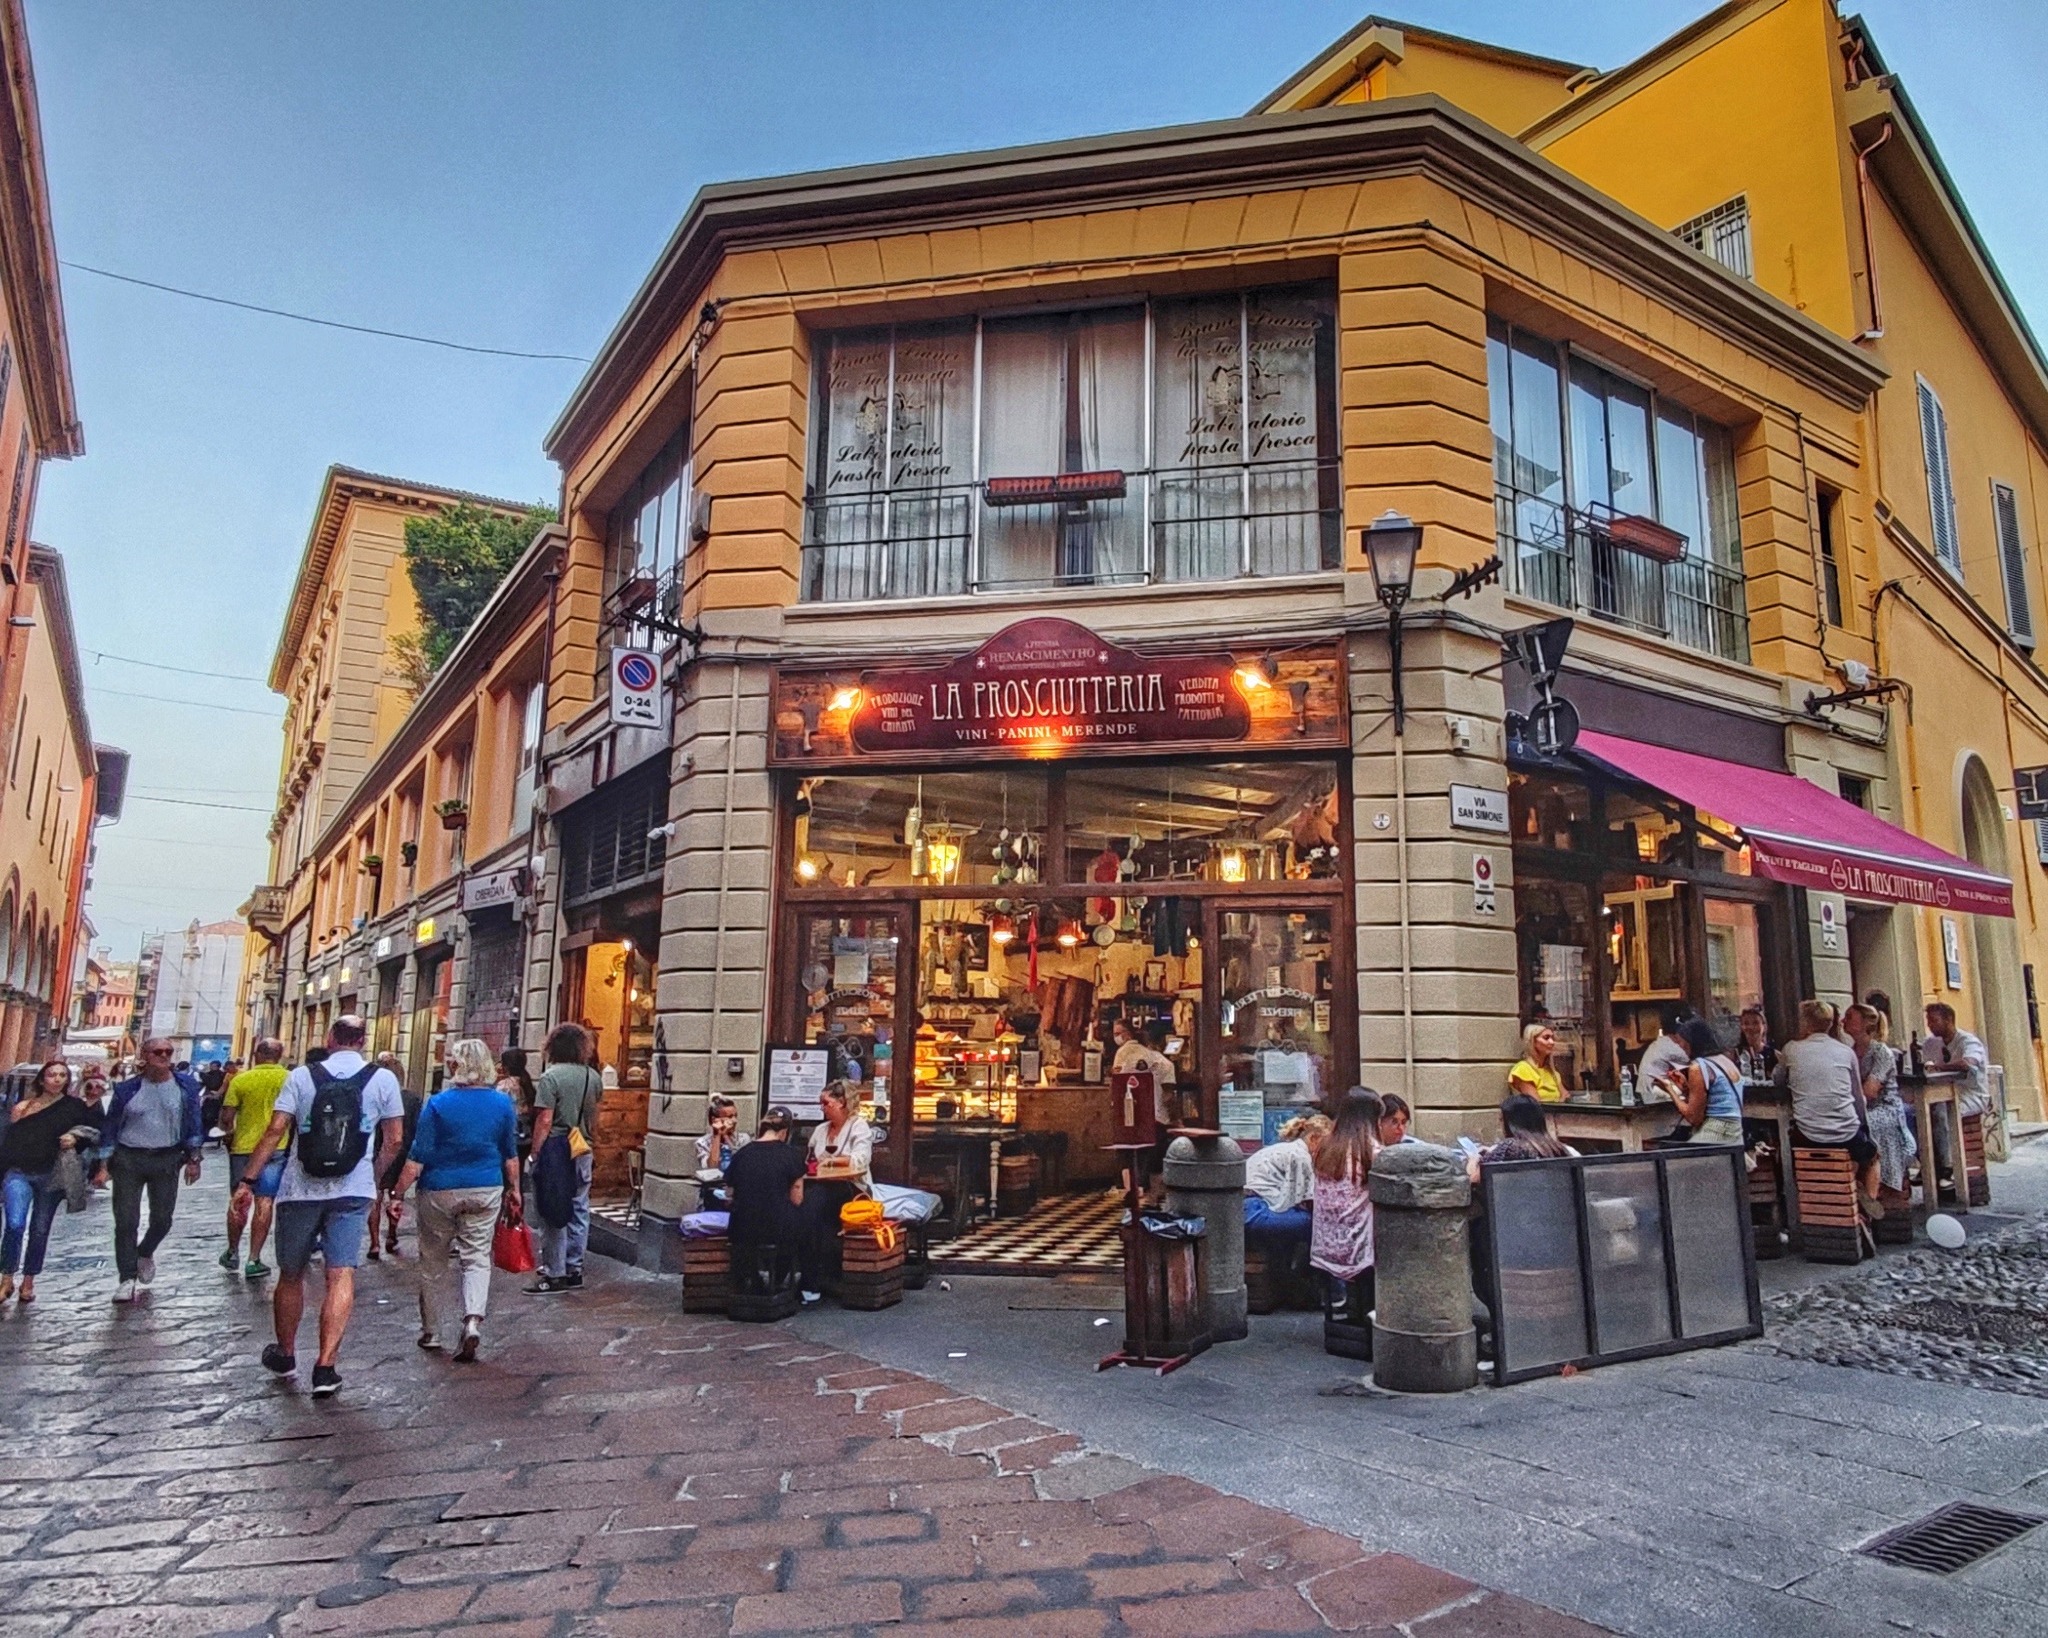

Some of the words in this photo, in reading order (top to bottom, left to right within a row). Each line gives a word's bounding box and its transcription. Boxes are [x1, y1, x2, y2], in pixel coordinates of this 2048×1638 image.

[1186, 412, 1306, 435] Laboatorio
[836, 442, 943, 462] Laboatorio
[1179, 438, 1240, 462] pasta
[1252, 432, 1316, 457] fresca
[828, 467, 882, 489] pasta
[893, 461, 951, 485] fresca
[990, 648, 1095, 662] RENASCIMENTHO
[1179, 677, 1219, 691] VENDITA
[624, 696, 651, 707] 0-24
[870, 692, 924, 709] PRODUZIONE
[931, 683, 964, 720] LA
[973, 673, 1166, 718] PROSCIUTTERIA
[1174, 692, 1215, 705] PRODOTTI
[881, 707, 898, 718] VINI
[1178, 706, 1223, 721] FATTORIA
[881, 719, 916, 733] CHIANTI
[956, 729, 987, 740] VINI
[998, 726, 1051, 739] PANINI
[1061, 724, 1138, 737] MERENDE
[1474, 797, 1487, 808] VIA
[1458, 807, 1473, 819] SAN
[1475, 809, 1503, 823] SIMONE
[1791, 859, 1829, 875] TAGLIERI
[1847, 867, 1863, 891] LA
[1864, 870, 1936, 903] PROSCIUTTERIA
